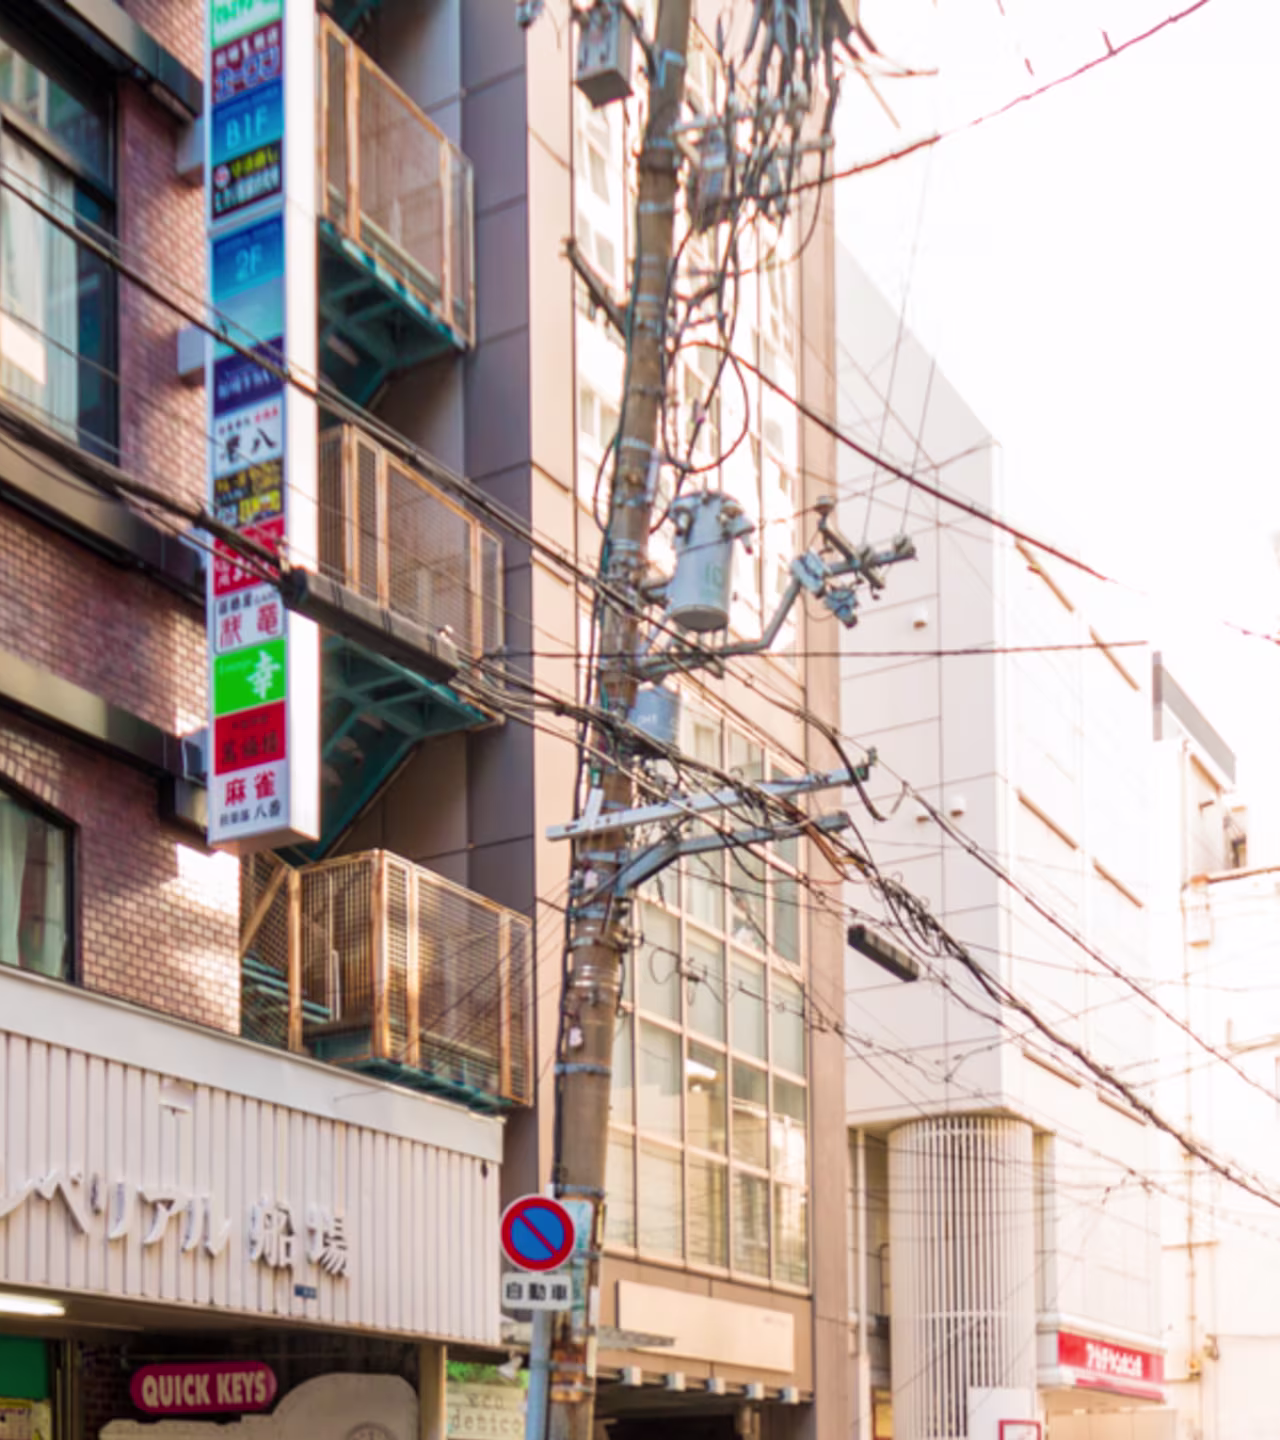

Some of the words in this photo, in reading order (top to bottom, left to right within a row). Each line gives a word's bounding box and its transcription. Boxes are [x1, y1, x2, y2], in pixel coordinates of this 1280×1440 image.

[246, 648, 282, 701] 幸
[223, 770, 277, 808] 麻雀
[506, 1282, 568, 1301] 自動車
[142, 1373, 211, 1409] QUICK
[216, 1370, 268, 1405] KEYS
